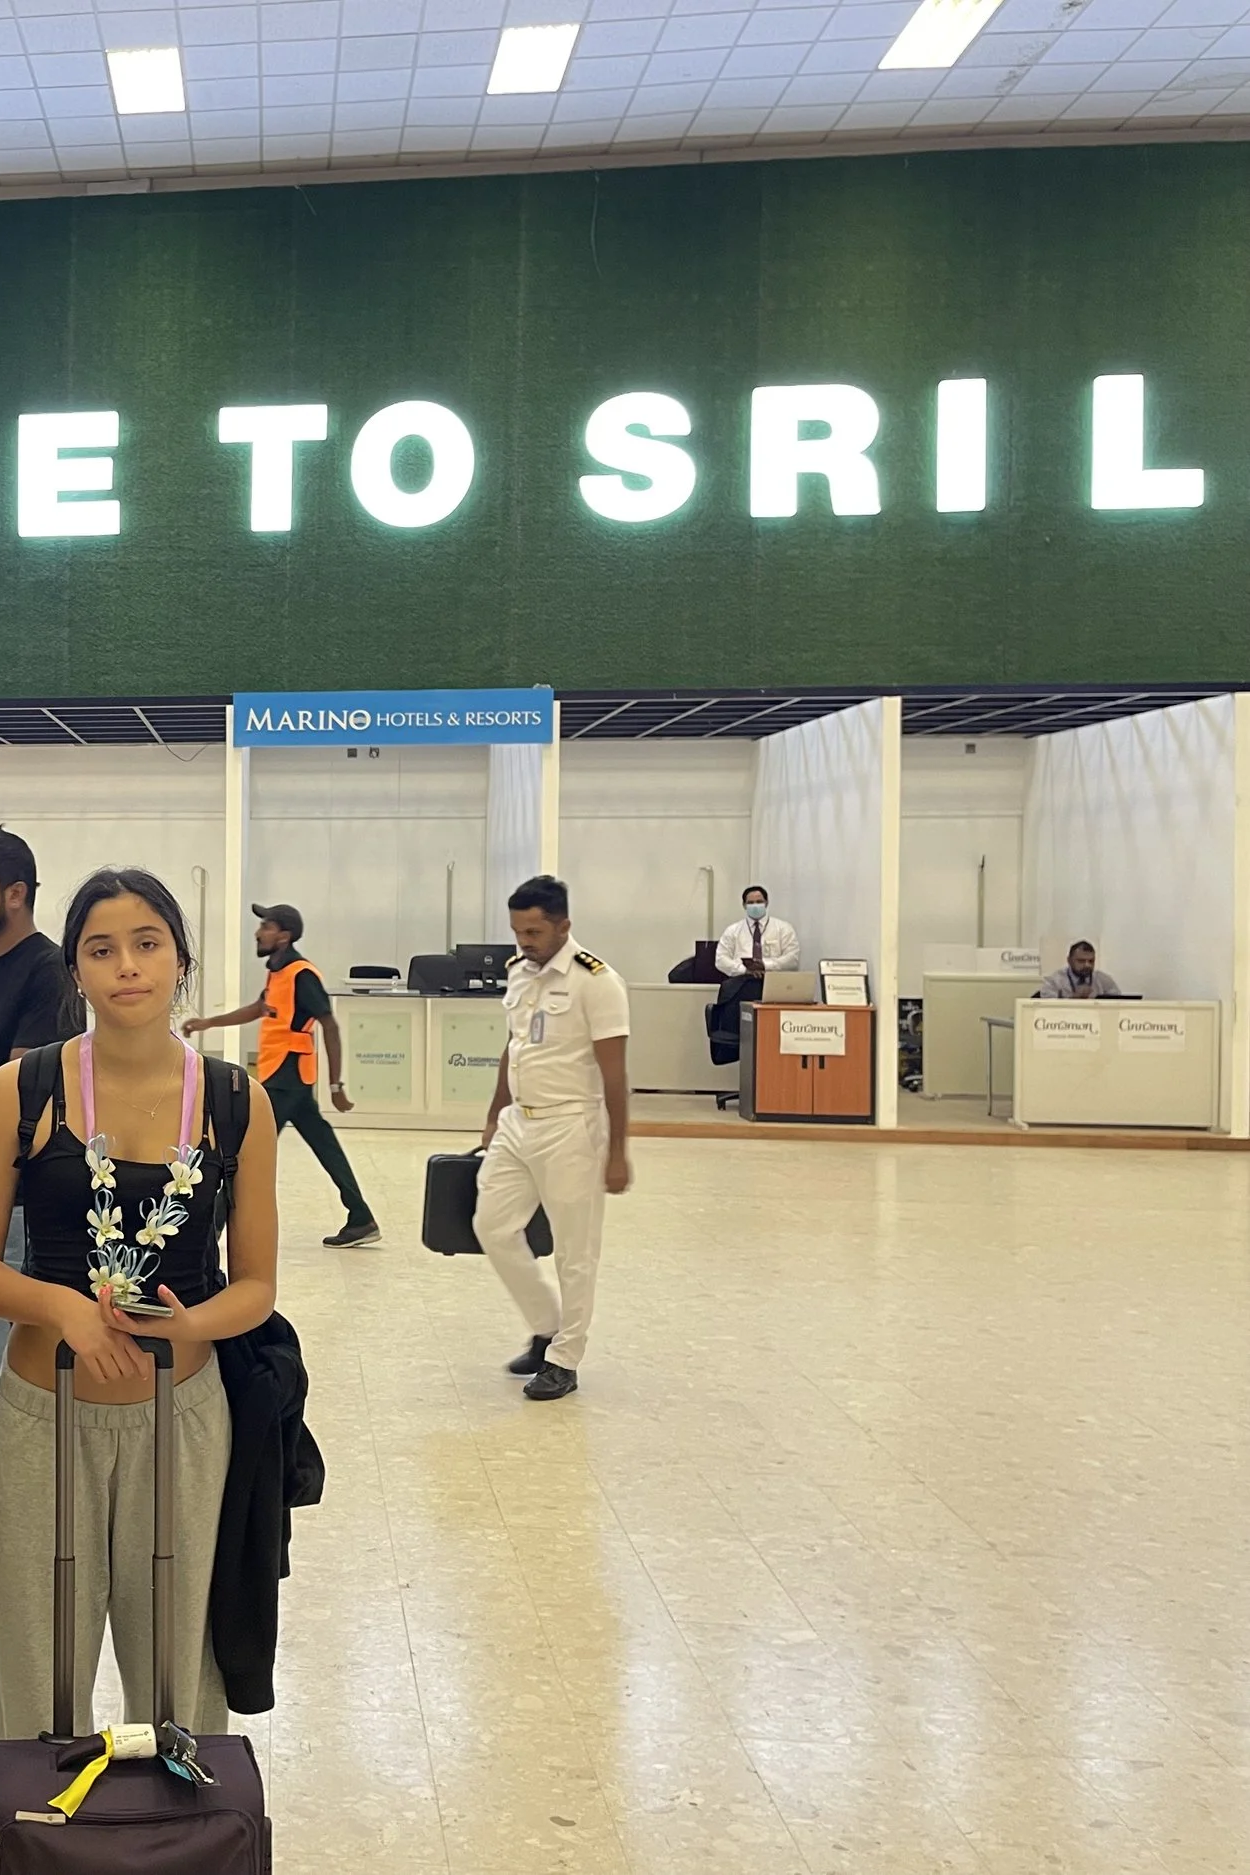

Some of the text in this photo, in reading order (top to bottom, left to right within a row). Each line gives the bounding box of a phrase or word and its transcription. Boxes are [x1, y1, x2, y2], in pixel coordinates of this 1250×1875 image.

[220, 402, 474, 531] TO
[580, 379, 986, 521] SRI
[1093, 375, 1203, 509] L
[245, 707, 542, 731] MARINO HOTELS & RESORTS
[1000, 950, 1041, 963] Cinnam
[781, 1020, 844, 1037] Cinnamon
[1034, 1017, 1099, 1035] Cinnamon
[1119, 1018, 1184, 1035] Cinnamon
